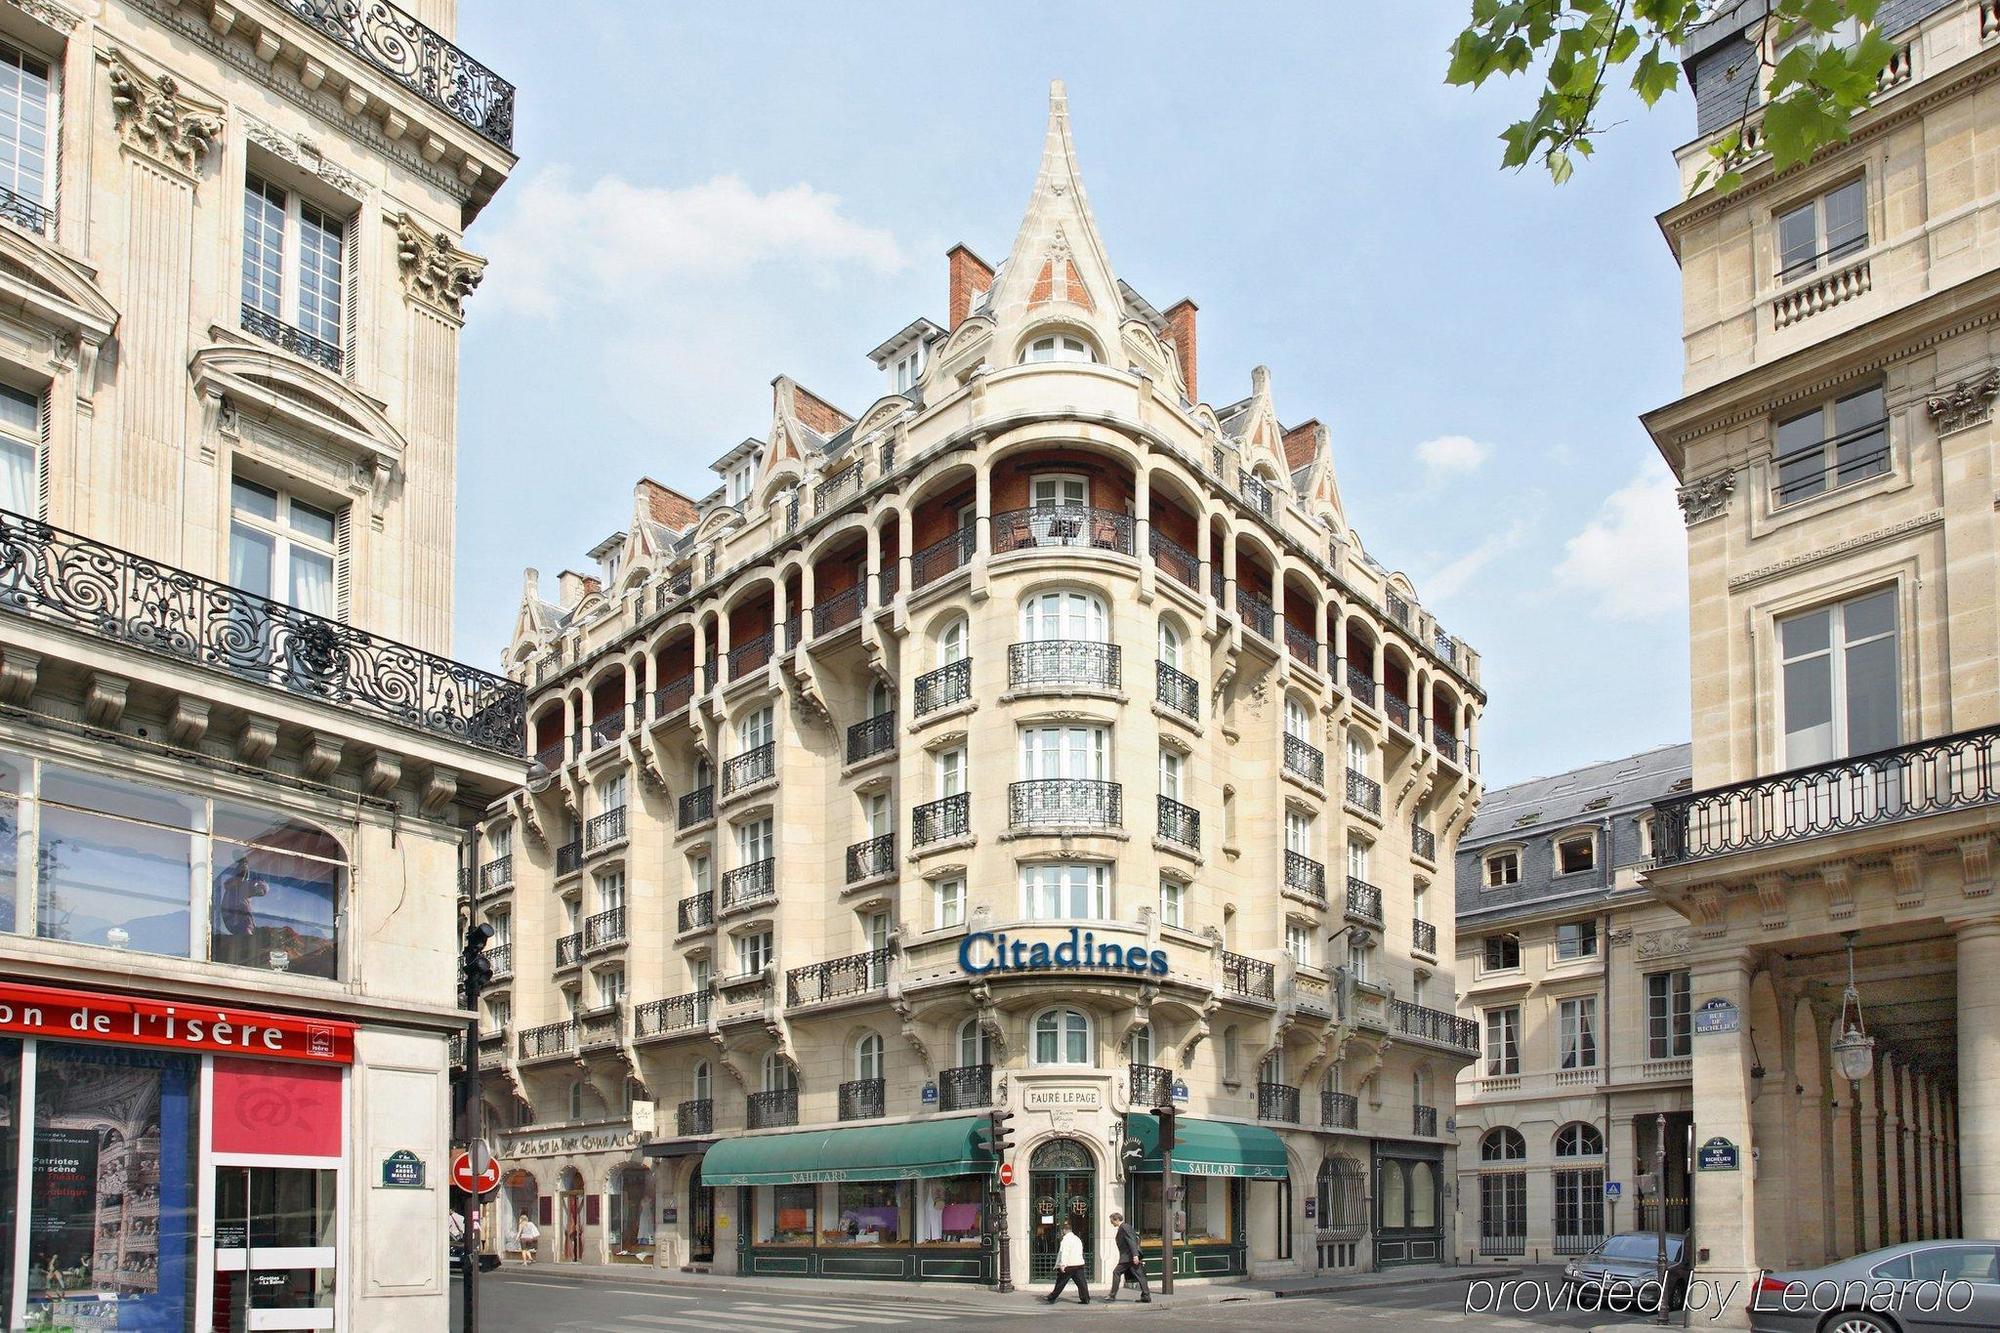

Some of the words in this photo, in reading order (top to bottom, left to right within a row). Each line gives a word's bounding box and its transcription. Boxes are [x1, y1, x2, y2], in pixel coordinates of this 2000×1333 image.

[959, 926, 1169, 975] Citadines
[70, 1007, 111, 1033] de
[133, 1008, 283, 1050] l'isère
[1697, 1023, 1736, 1033] RICHELIEU
[1031, 1091, 1060, 1104] FAURÉ
[1063, 1092, 1074, 1103] LE
[1076, 1092, 1097, 1104] PAGE
[33, 1158, 79, 1166] Patriotes
[48, 1164, 77, 1172] scène
[1188, 1162, 1236, 1176] SAILLARD
[792, 1170, 847, 1184] SAILLARD
